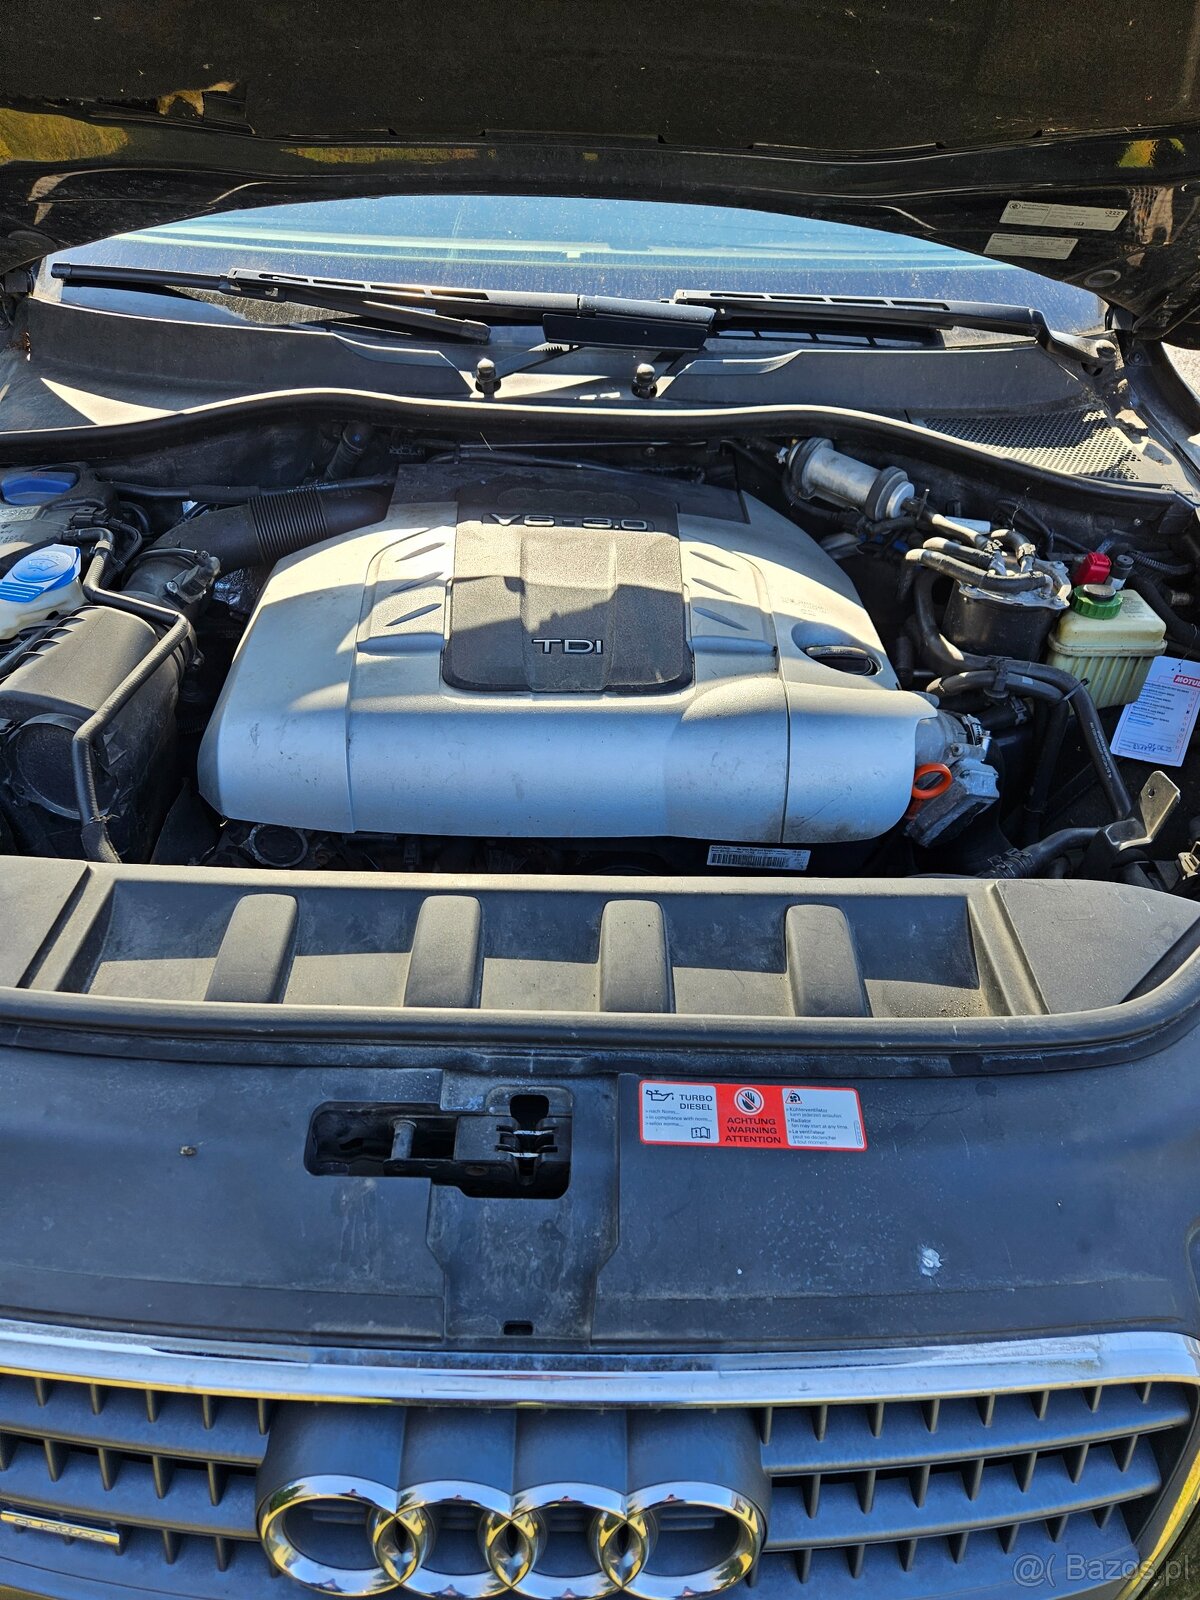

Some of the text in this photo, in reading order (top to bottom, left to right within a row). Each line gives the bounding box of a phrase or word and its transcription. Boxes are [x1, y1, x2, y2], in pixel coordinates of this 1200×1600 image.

[532, 639, 603, 654] TDI
[679, 1094, 713, 1102] TURBO
[680, 1103, 713, 1111] DIESEL
[727, 1117, 776, 1125] ACHTUNG
[727, 1126, 777, 1134] WARNING
[725, 1135, 781, 1143] ATTENTION
